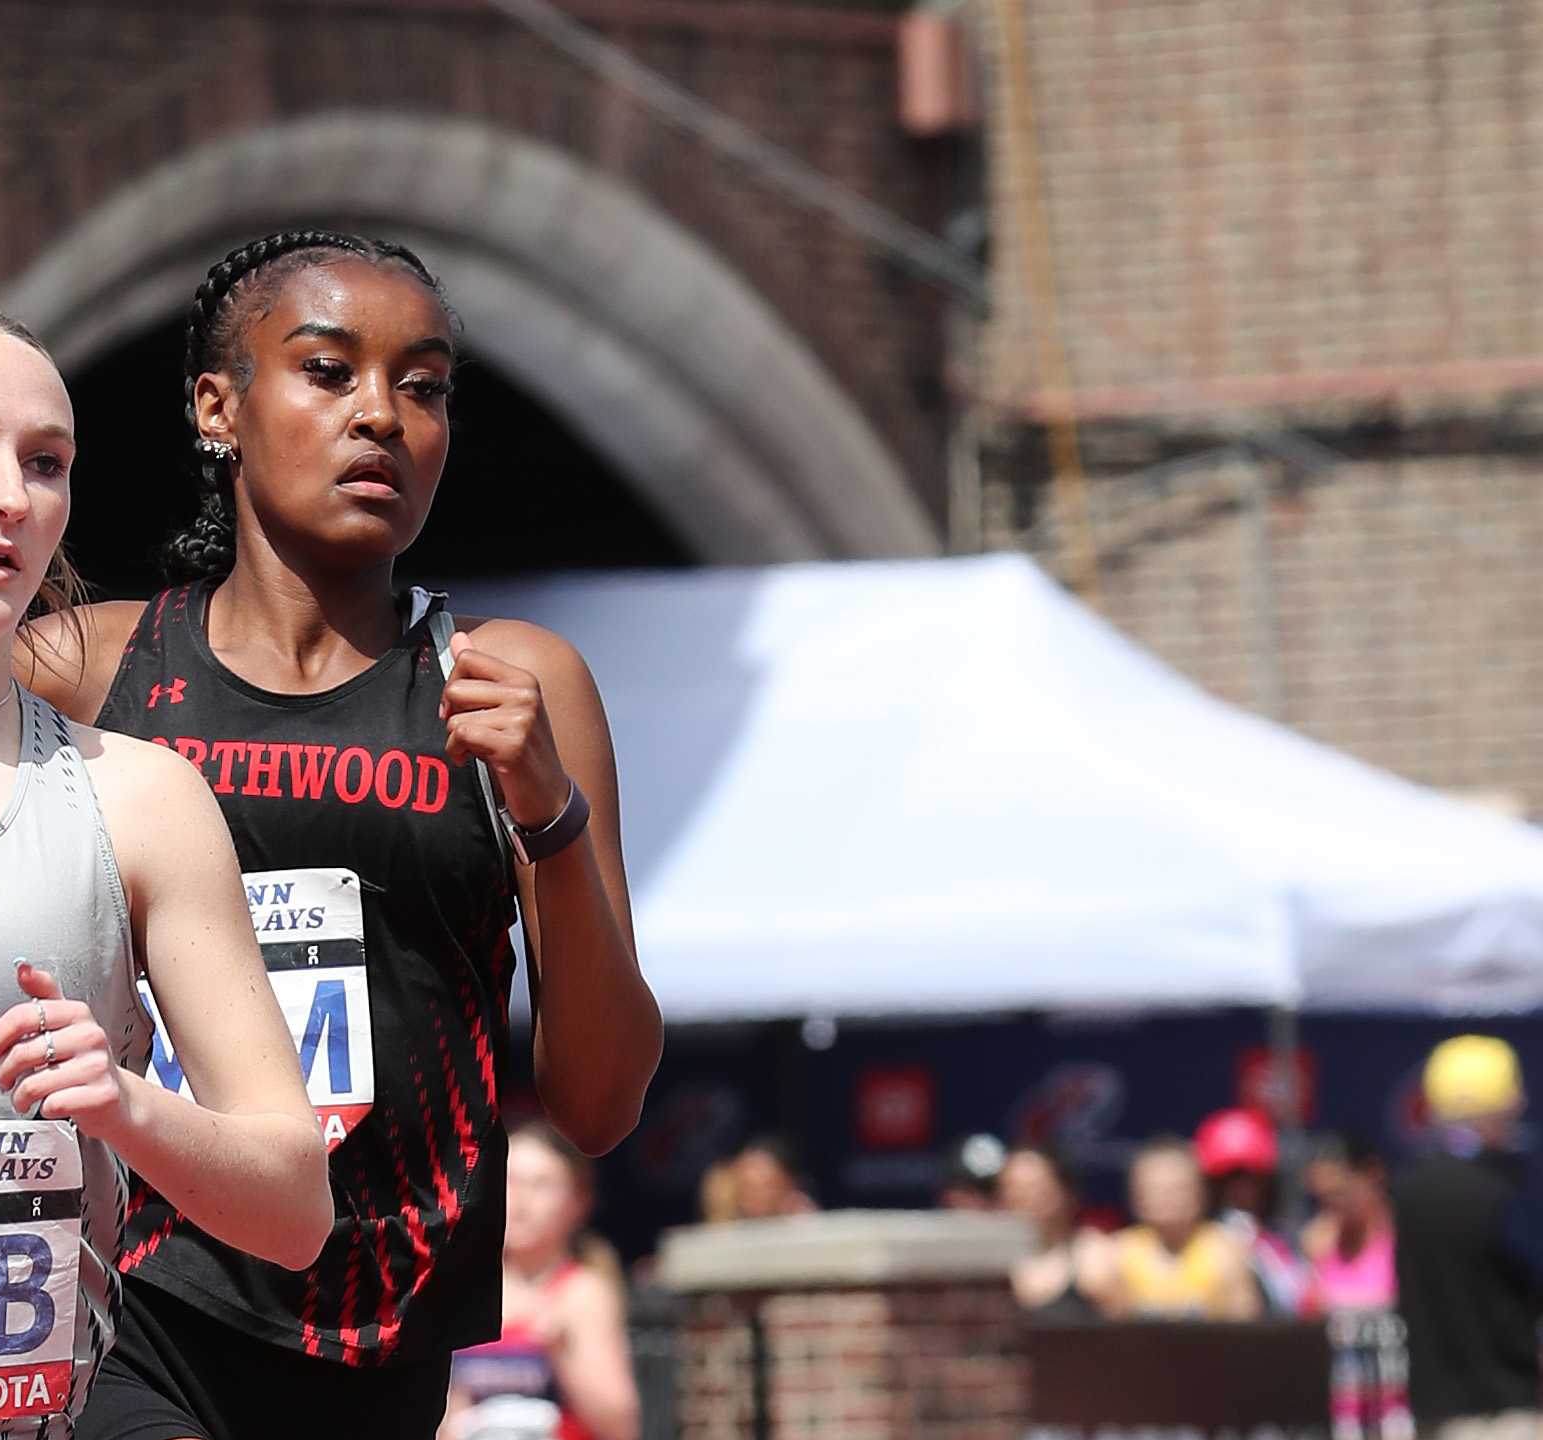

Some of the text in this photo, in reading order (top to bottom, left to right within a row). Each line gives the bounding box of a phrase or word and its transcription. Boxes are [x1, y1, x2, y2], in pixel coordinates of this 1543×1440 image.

[150, 735, 451, 814] RTHWOOD
[247, 882, 295, 906] NN
[254, 906, 325, 932] AYS
